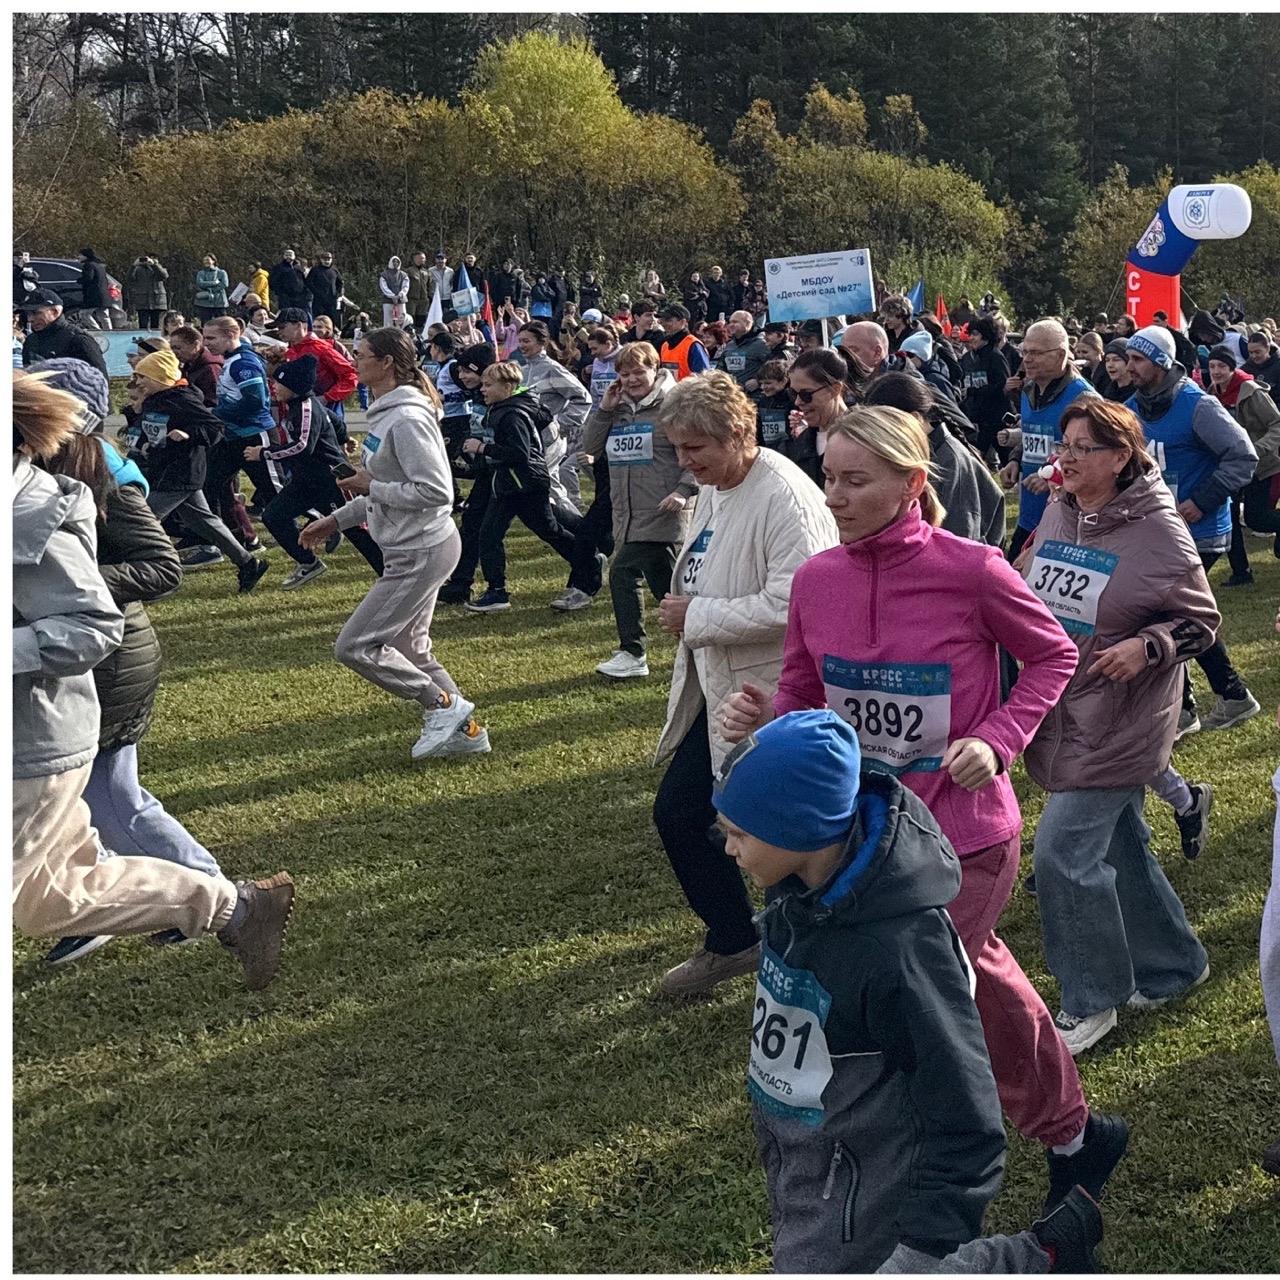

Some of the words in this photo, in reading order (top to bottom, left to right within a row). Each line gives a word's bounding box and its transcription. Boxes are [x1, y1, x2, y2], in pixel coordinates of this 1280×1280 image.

[801, 275, 834, 287] МБДОУ
[819, 286, 836, 295] сад
[613, 436, 643, 452] 3502
[1024, 436, 1046, 454] 3871
[1062, 545, 1088, 560] КРОСС
[1034, 564, 1090, 601] 3732
[1055, 601, 1082, 615] ОБЛАСТЬ
[862, 668, 903, 683] КРОСС
[843, 697, 924, 743] 3892
[859, 741, 888, 753] МСКАЯ
[762, 954, 794, 992] КРОСС
[753, 997, 813, 1071] 261
